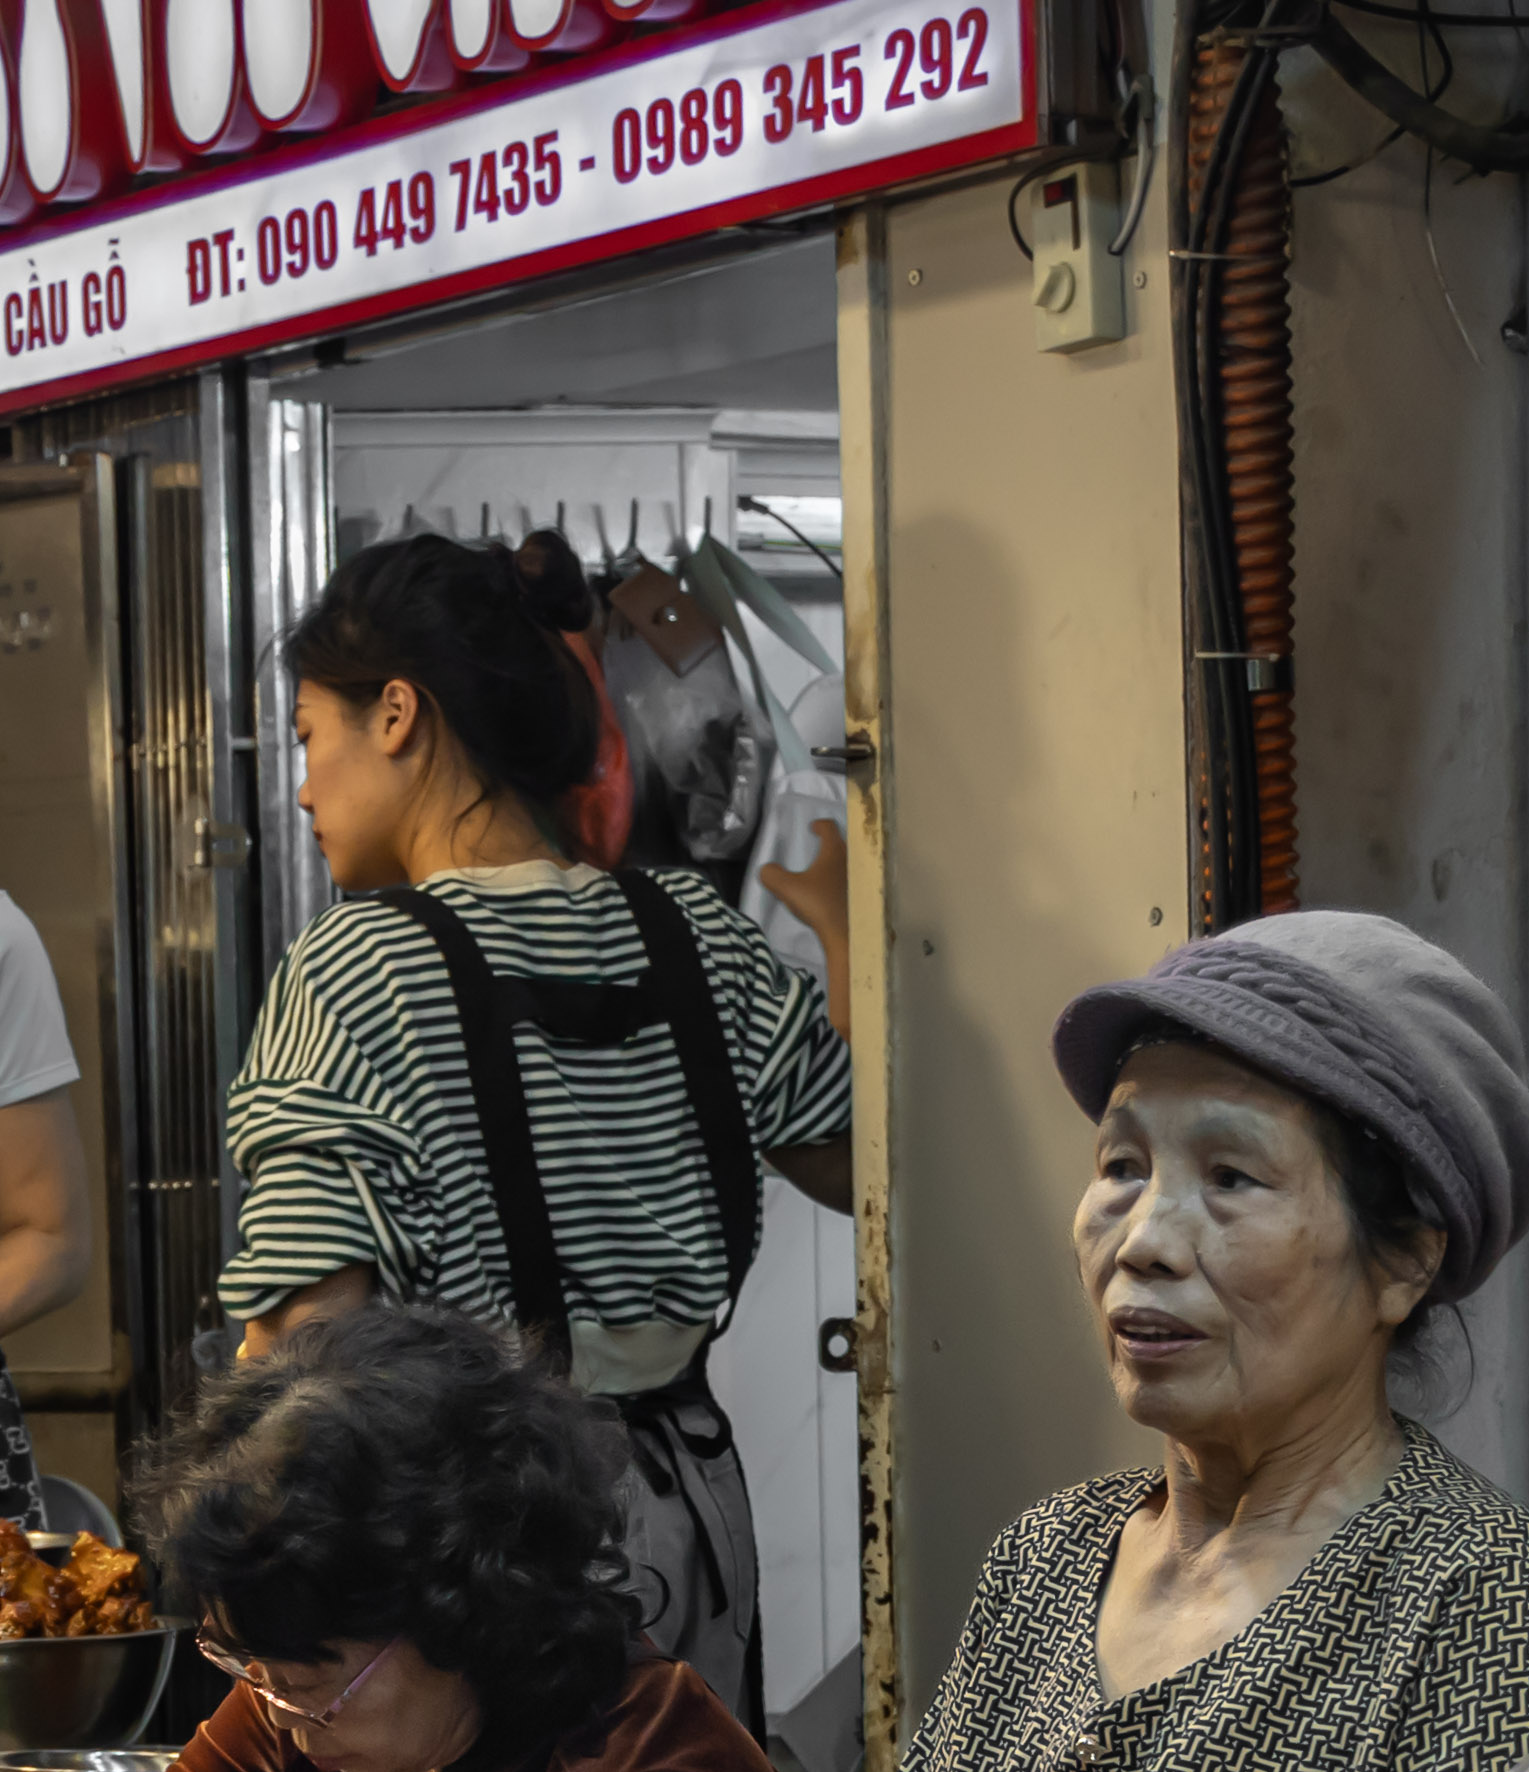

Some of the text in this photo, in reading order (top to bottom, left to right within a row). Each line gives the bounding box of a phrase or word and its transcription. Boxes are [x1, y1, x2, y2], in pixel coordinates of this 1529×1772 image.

[5, 259, 69, 356] CẦU
[82, 238, 126, 337] GỖ
[186, 228, 245, 306] ĐT:
[257, 200, 338, 285] 090
[354, 171, 435, 256] 449
[449, 130, 561, 232] 7435
[612, 78, 743, 184] 0989
[762, 44, 863, 144] 345
[884, 8, 989, 111] 292
